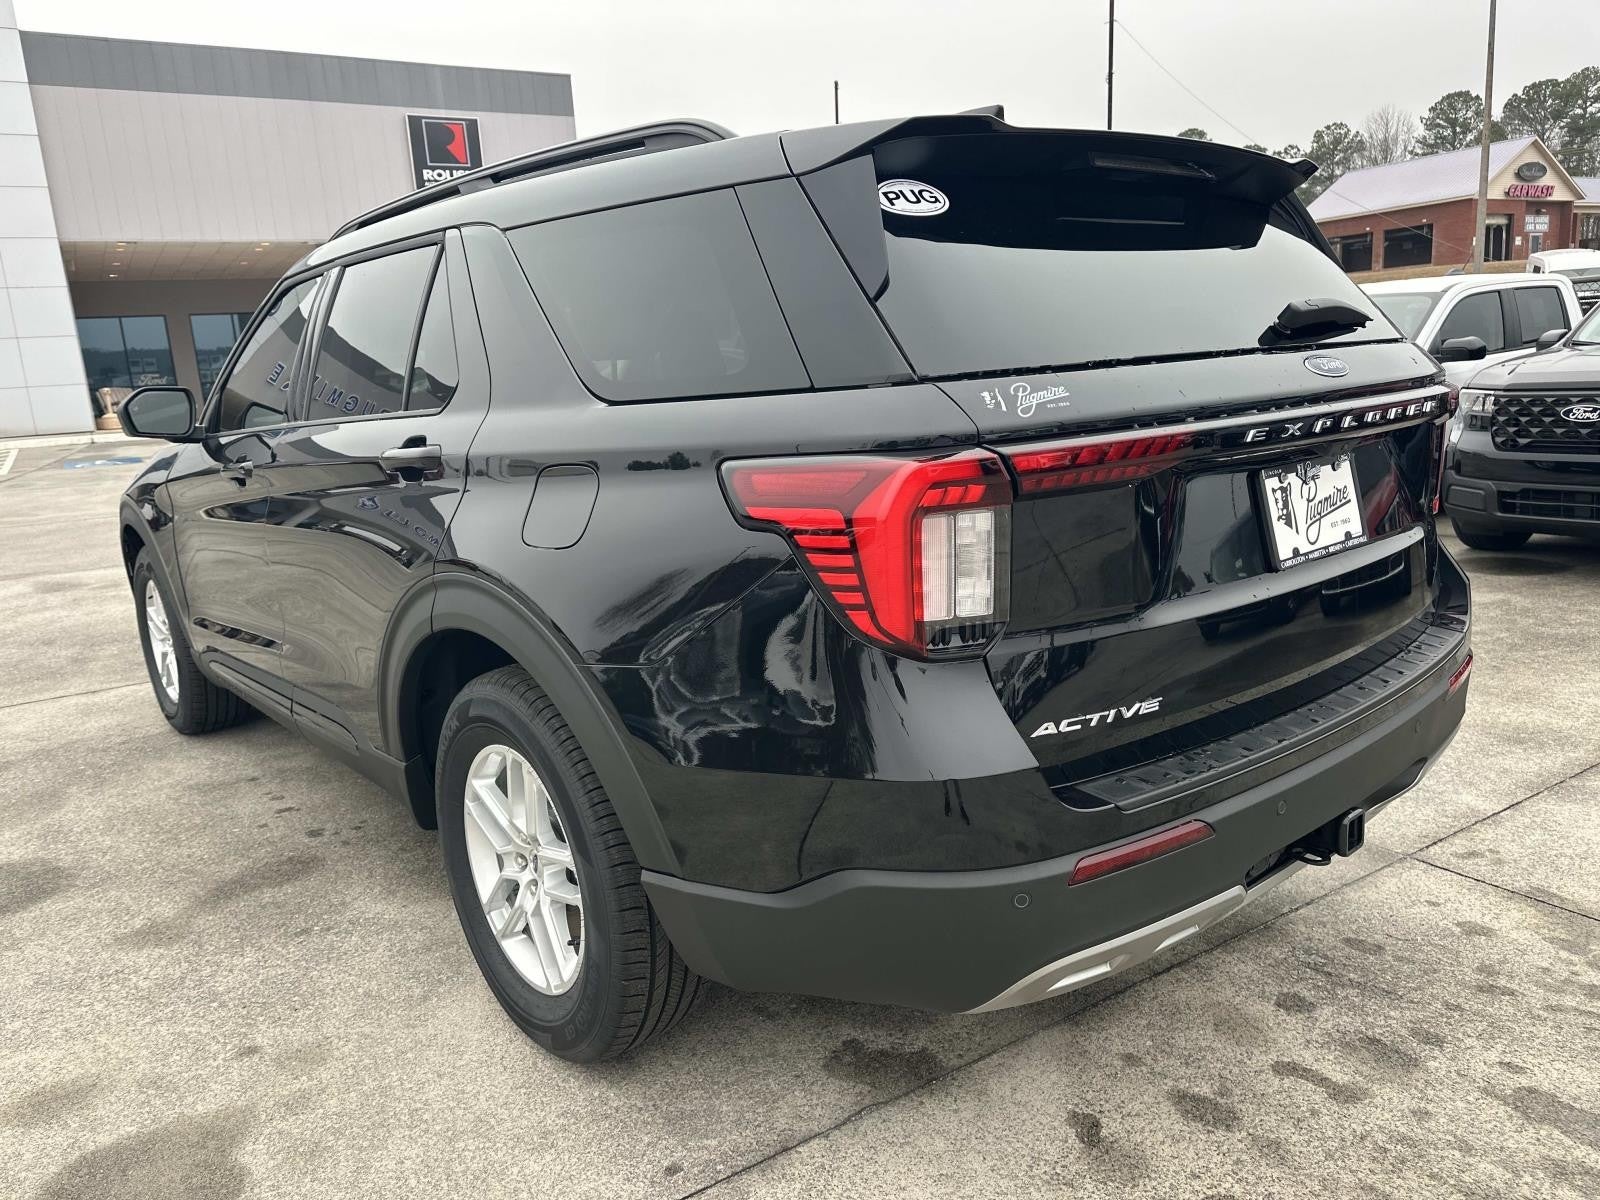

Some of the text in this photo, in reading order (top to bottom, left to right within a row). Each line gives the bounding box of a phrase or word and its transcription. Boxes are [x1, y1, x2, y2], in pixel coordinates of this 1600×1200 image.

[422, 169, 471, 181] ROUS
[881, 189, 942, 206] PUG
[1508, 184, 1555, 198] CARWASH
[1317, 358, 1344, 370] Ford
[138, 373, 169, 386] Ford
[1010, 382, 1070, 418] Pugmire
[1569, 407, 1600, 419] Ford
[1244, 401, 1442, 443] EXPLORER
[1301, 479, 1351, 545] Pugmire
[1029, 697, 1163, 738] ACTIVE
